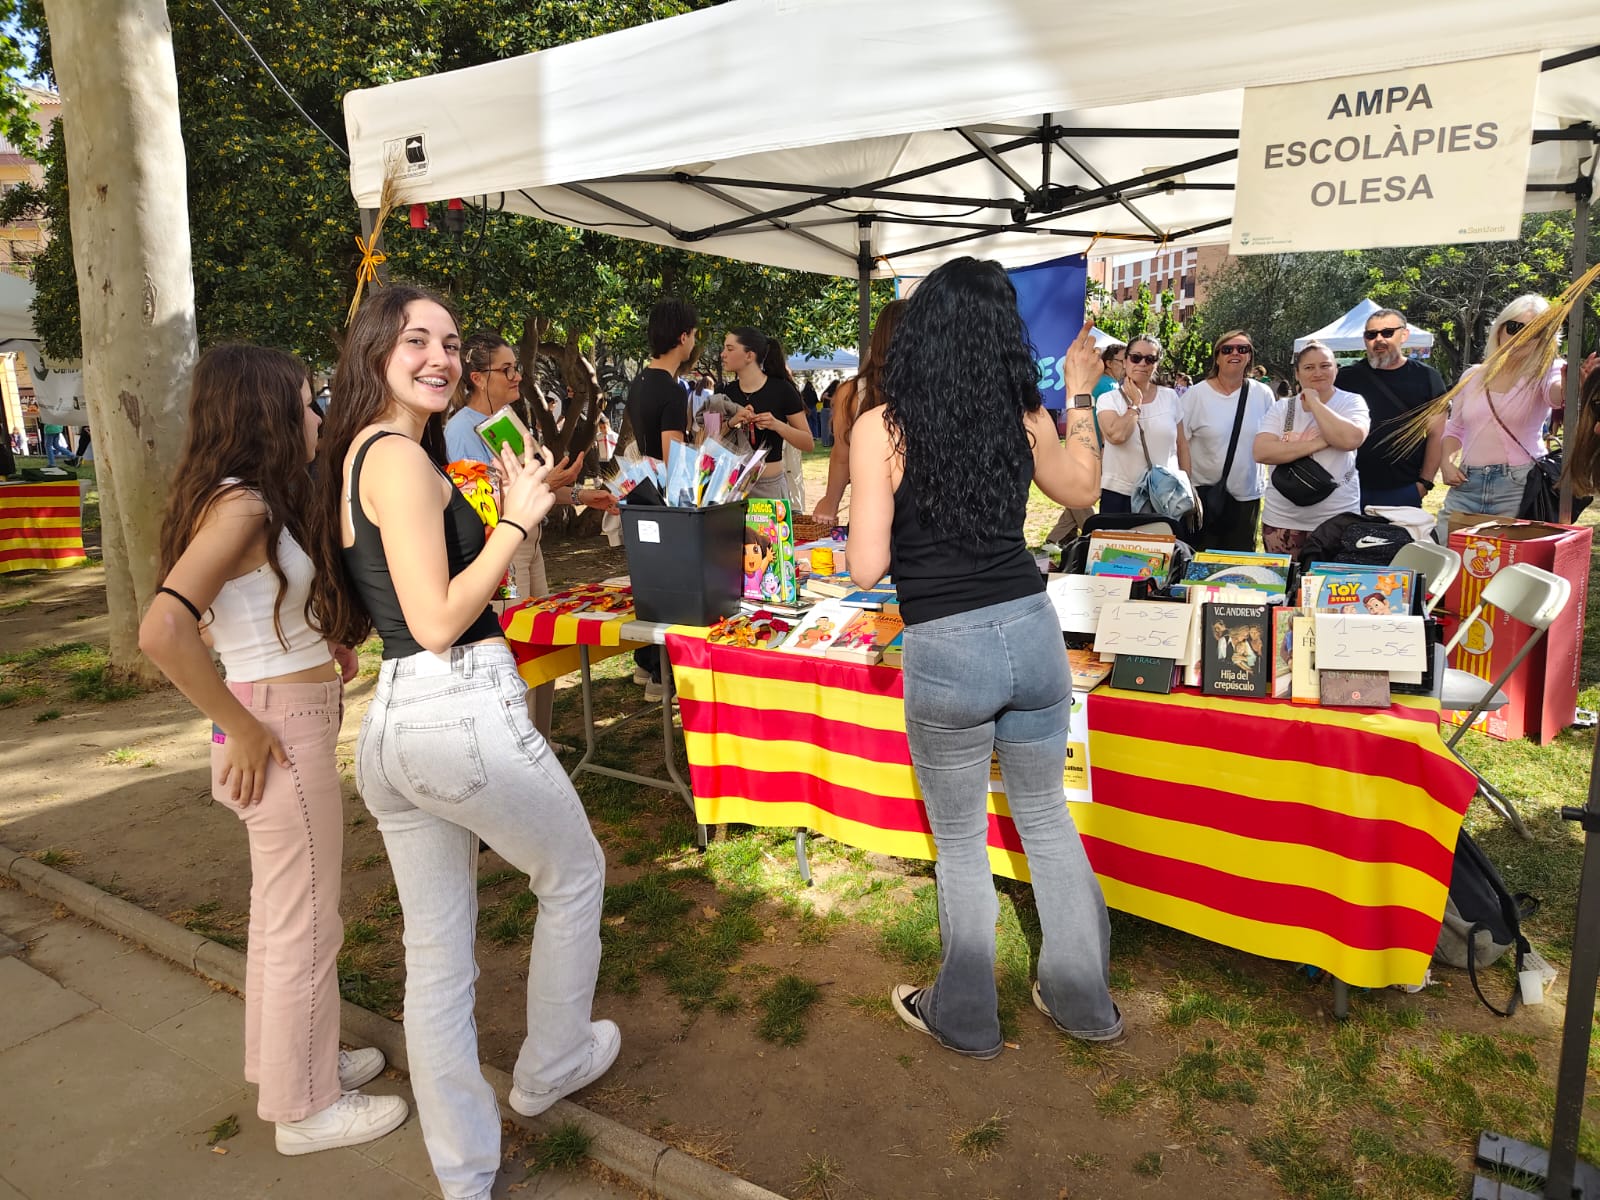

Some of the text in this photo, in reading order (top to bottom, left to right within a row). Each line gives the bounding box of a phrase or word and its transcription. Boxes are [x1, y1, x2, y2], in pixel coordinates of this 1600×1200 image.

[1327, 83, 1433, 120] AMPA
[1263, 122, 1499, 169] ESCOLÀPIES
[1311, 174, 1434, 207] OLESA
[1327, 582, 1361, 596] TOY
[1226, 607, 1261, 618] ANDREWS
[1221, 669, 1249, 680] Hija del
[1214, 681, 1255, 692] crepúsculo
